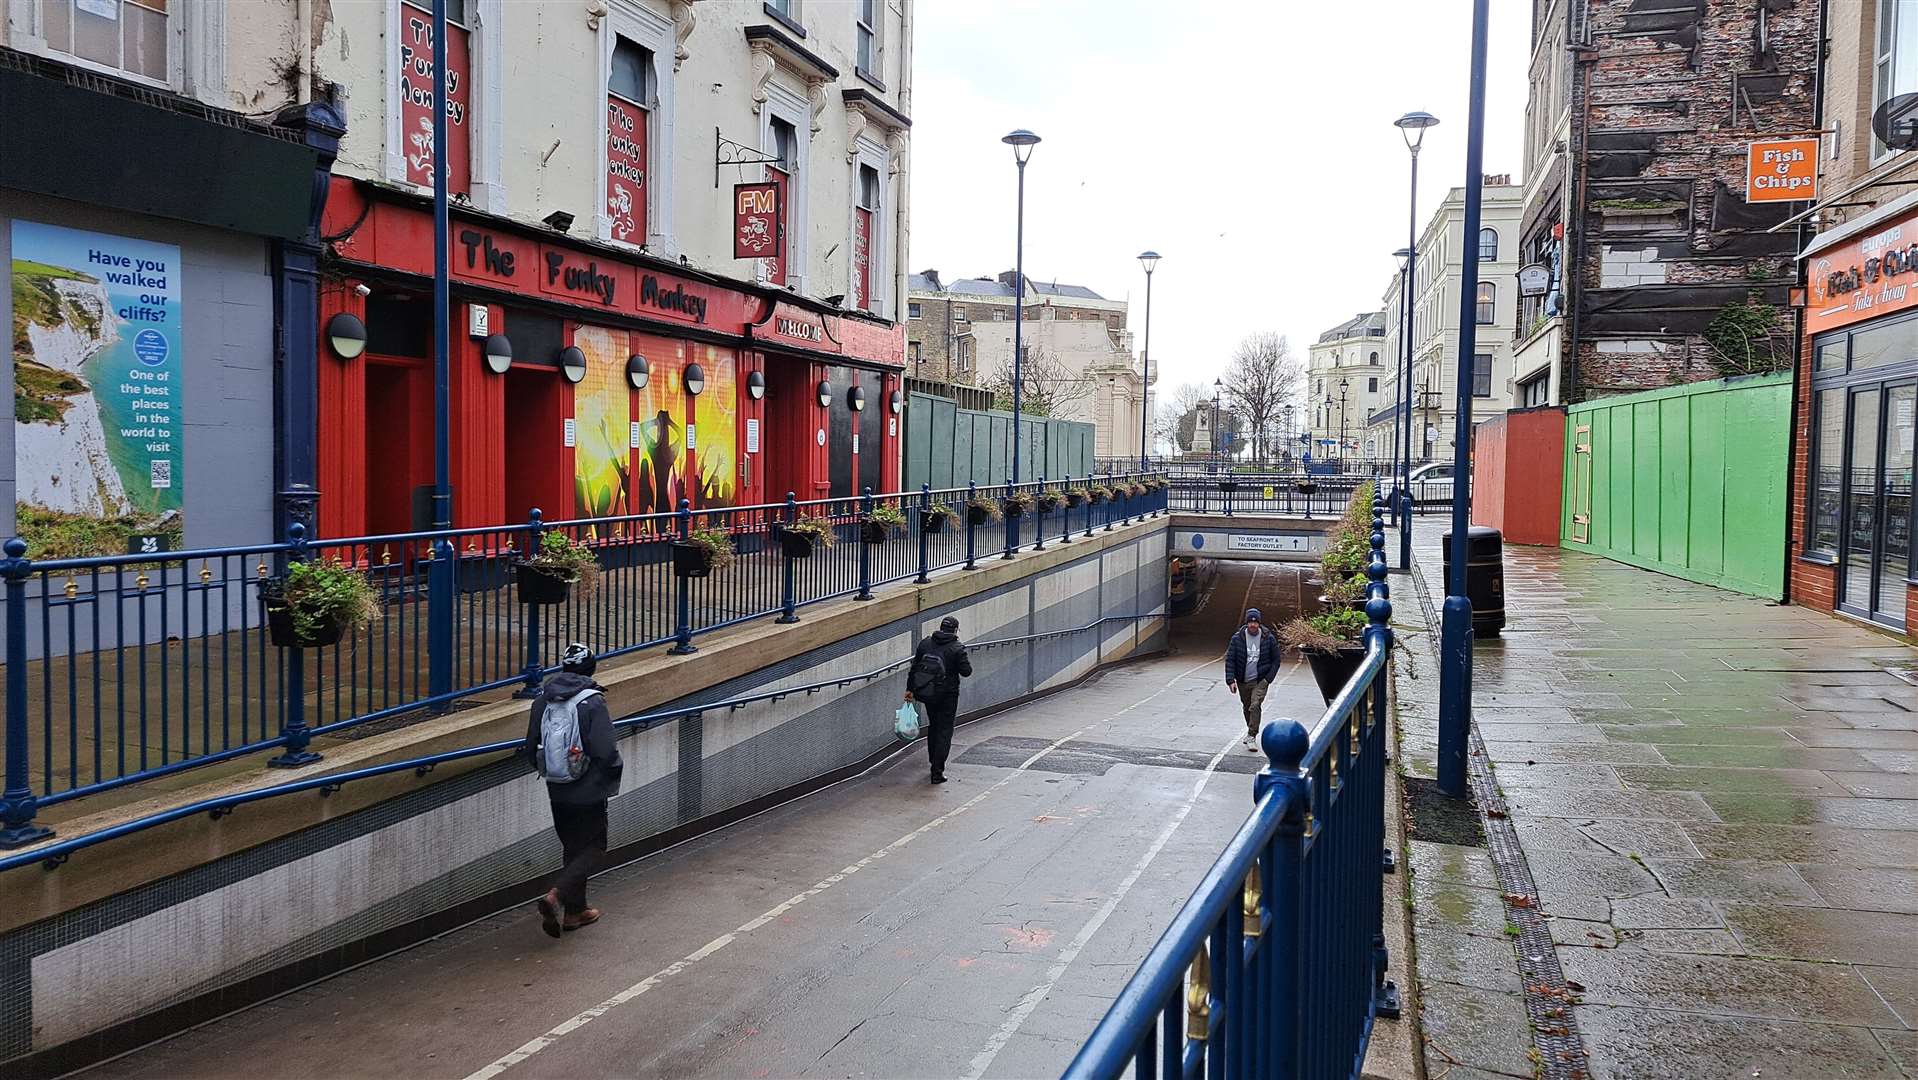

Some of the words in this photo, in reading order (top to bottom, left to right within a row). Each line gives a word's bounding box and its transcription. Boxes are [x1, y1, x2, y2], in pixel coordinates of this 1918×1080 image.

[609, 103, 633, 132] The
[1763, 149, 1804, 163] Fish
[608, 159, 644, 188] onkey
[1776, 163, 1791, 174] &
[1754, 175, 1811, 190] Chips
[738, 189, 775, 215] FM
[88, 249, 131, 267] Have
[136, 258, 166, 272] you
[106, 272, 166, 289] walked
[460, 230, 515, 277] The
[546, 252, 616, 306] Funky
[641, 274, 707, 324] Monkey
[140, 294, 167, 306] our
[119, 306, 167, 322] cliffs?
[776, 318, 822, 341] WELCOME
[129, 369, 153, 380] One
[157, 371, 169, 381] of
[120, 384, 140, 394] the
[144, 385, 168, 395] best
[132, 399, 169, 410] places
[136, 413, 147, 423] in
[150, 414, 170, 424] the
[121, 428, 155, 437] world
[158, 429, 170, 438] to
[146, 442, 170, 452] visit
